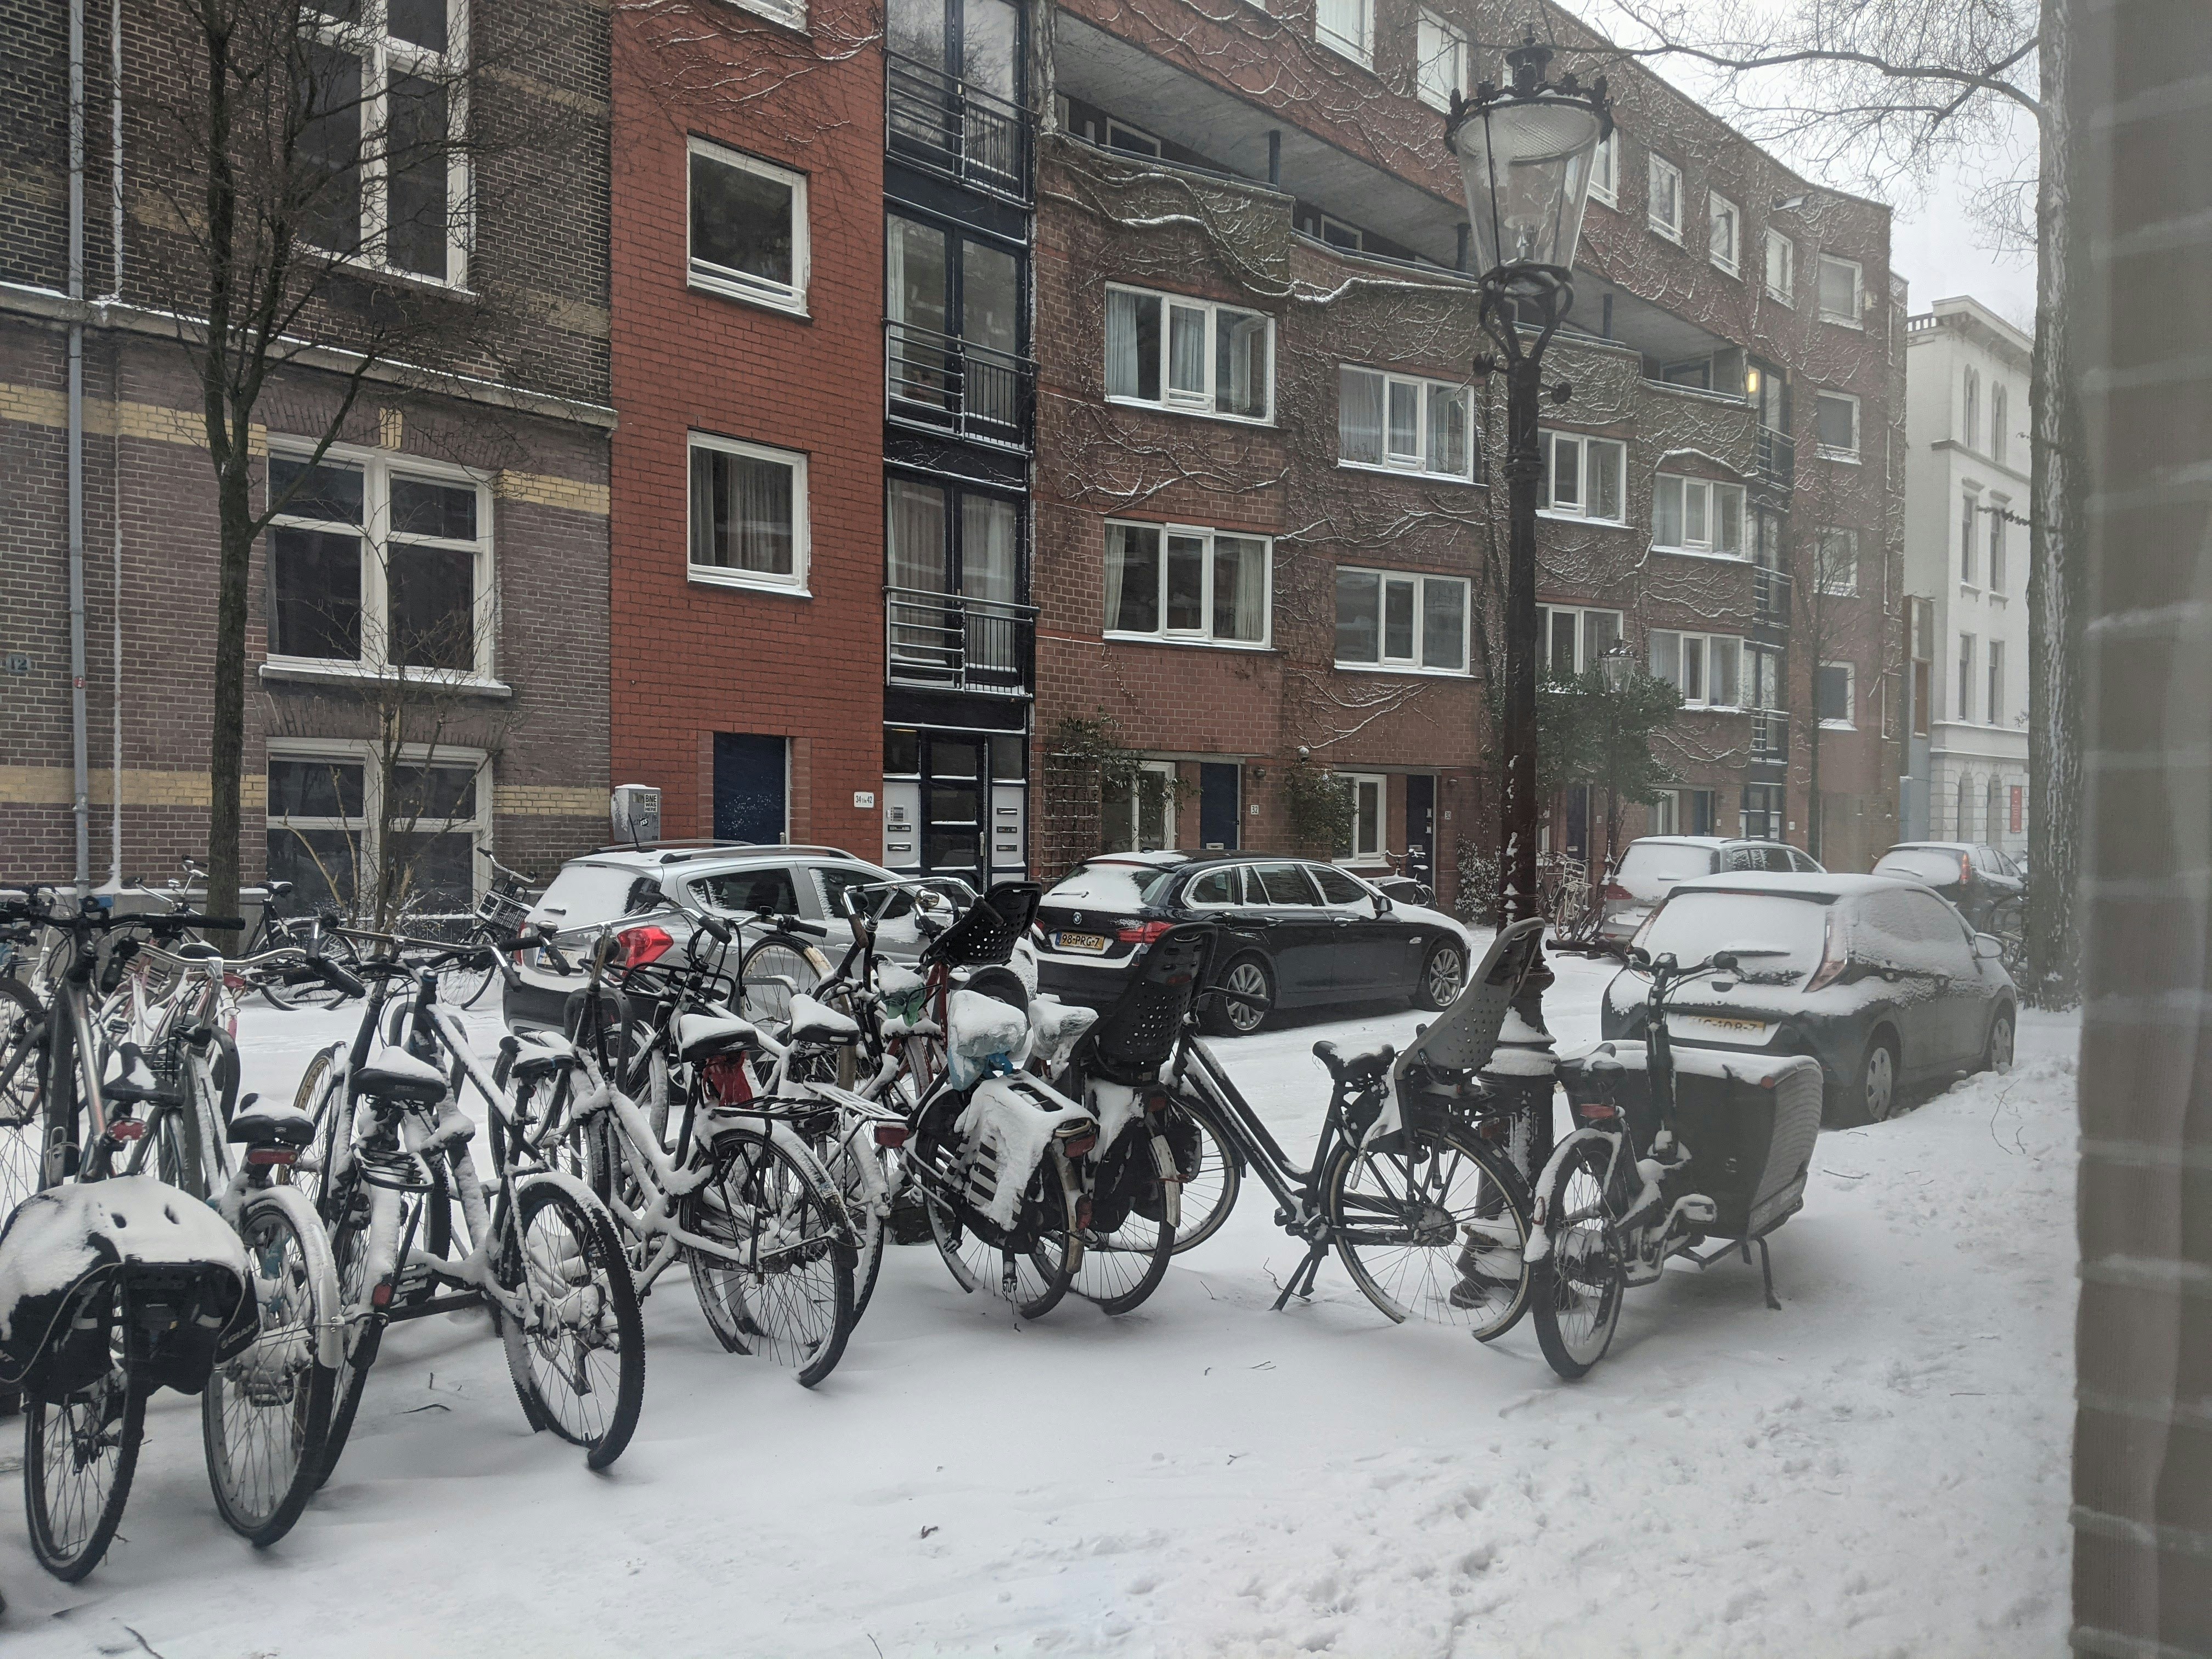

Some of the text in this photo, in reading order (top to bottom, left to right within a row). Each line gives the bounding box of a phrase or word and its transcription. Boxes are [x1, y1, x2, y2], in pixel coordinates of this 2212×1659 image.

[855, 795, 861, 803] 34
[867, 795, 872, 804] 42
[1062, 934, 1100, 946] 98-PRG-7
